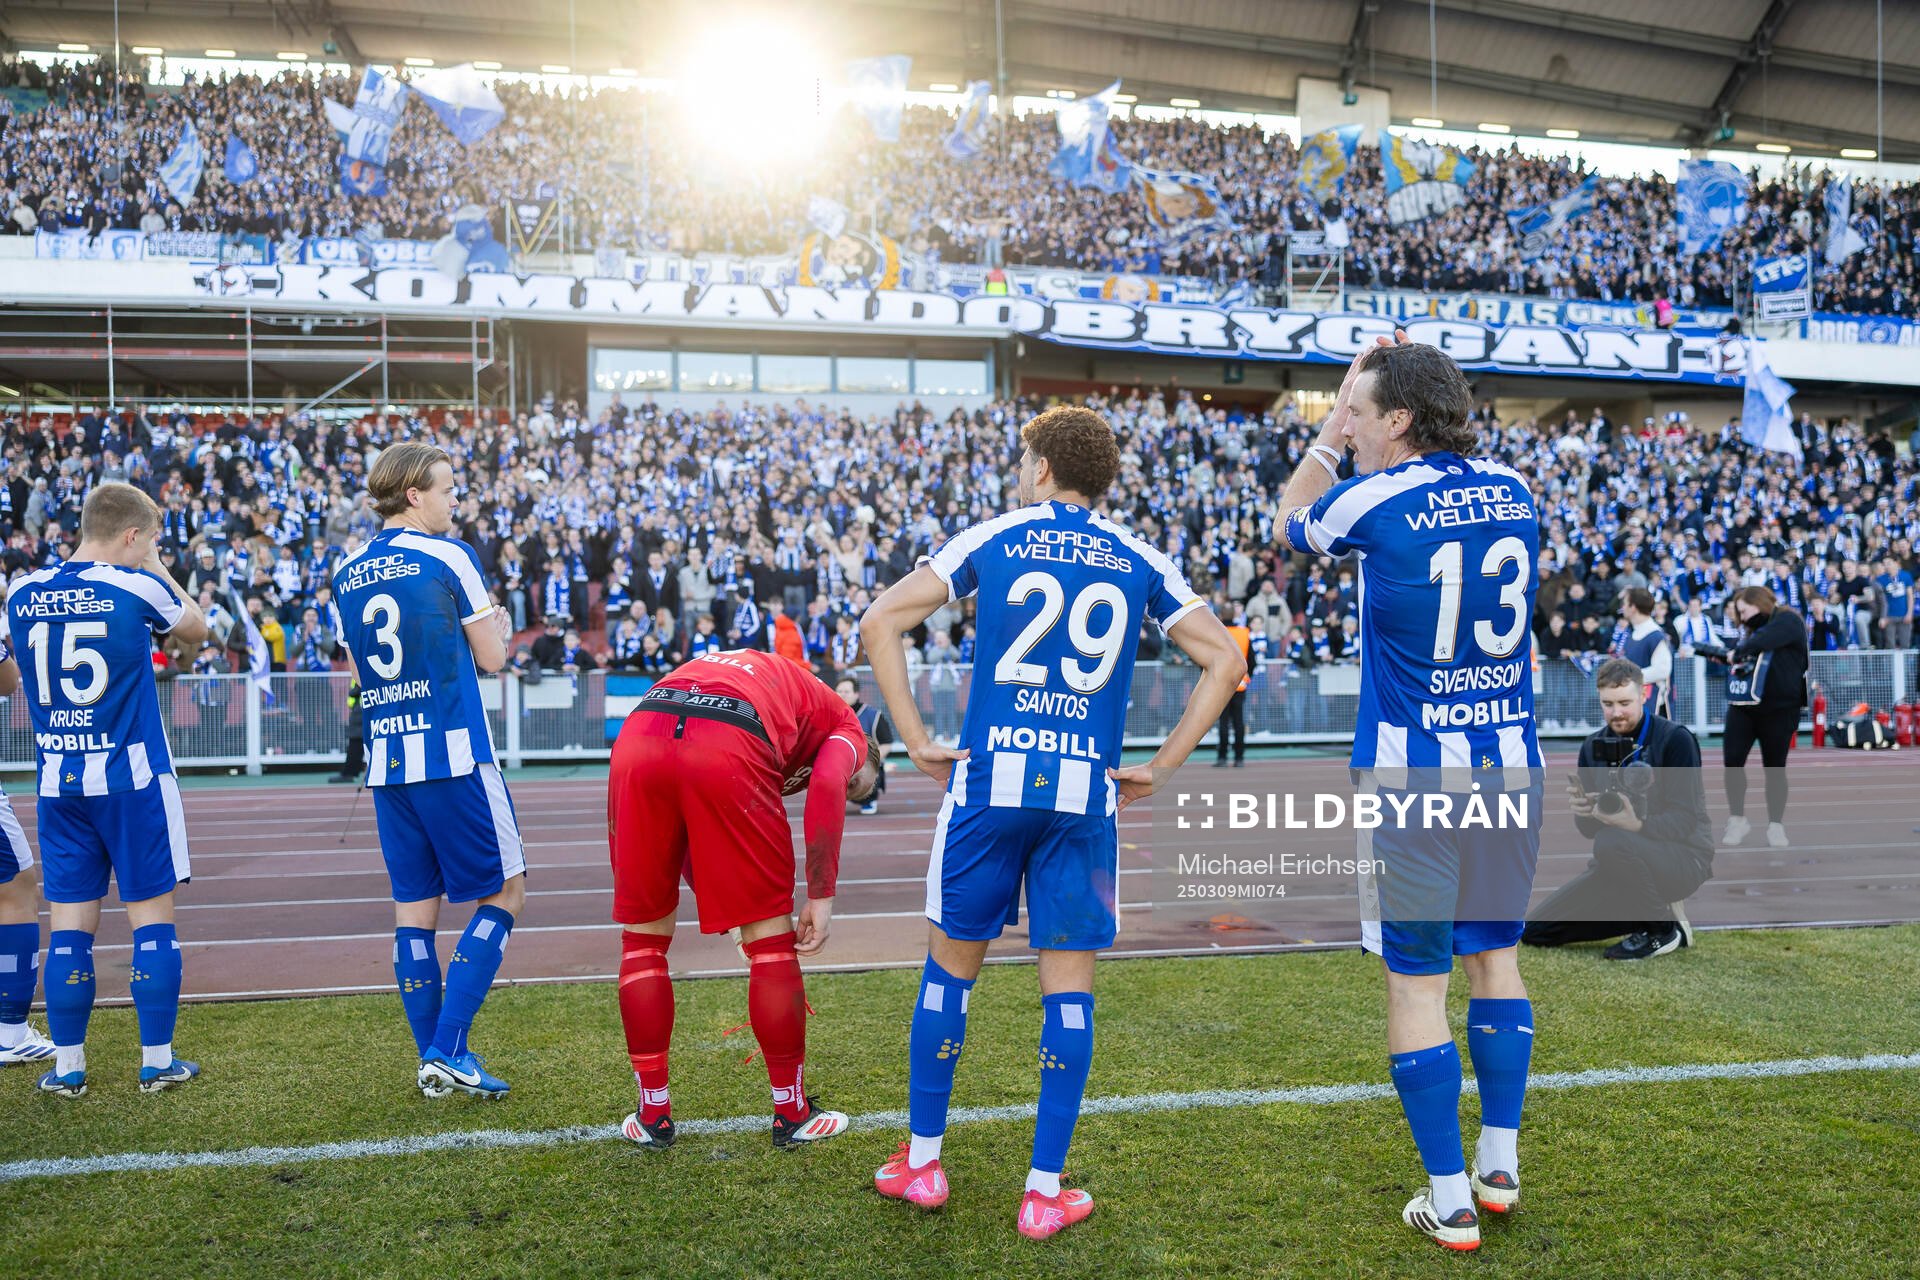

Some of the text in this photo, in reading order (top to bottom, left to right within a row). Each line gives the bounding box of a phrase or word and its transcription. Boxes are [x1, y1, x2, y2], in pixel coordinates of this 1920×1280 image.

[280, 263, 1679, 376] KOMMANDOBRYGGAN
[1711, 340, 1746, 373] 12
[1427, 485, 1513, 510] NORDIC
[1405, 503, 1533, 531] WELLNESS
[1026, 529, 1113, 553] NORDIC
[348, 553, 405, 579] NORDIC
[1004, 543, 1132, 573] WELLNESS
[339, 563, 421, 595] WELLNESS
[15, 600, 115, 617] WELLNESS
[30, 587, 96, 604] NORDIC
[1429, 536, 1531, 663] 13
[362, 593, 404, 681] 3
[994, 571, 1129, 695] 29
[28, 621, 109, 706] 15
[1429, 661, 1525, 694] SVENSSON
[49, 709, 94, 728] KRUSE
[1015, 689, 1090, 721] SANTOS
[1421, 697, 1530, 729] MOBILL
[36, 732, 116, 751] MOBILL
[987, 726, 1101, 760] MOBILL
